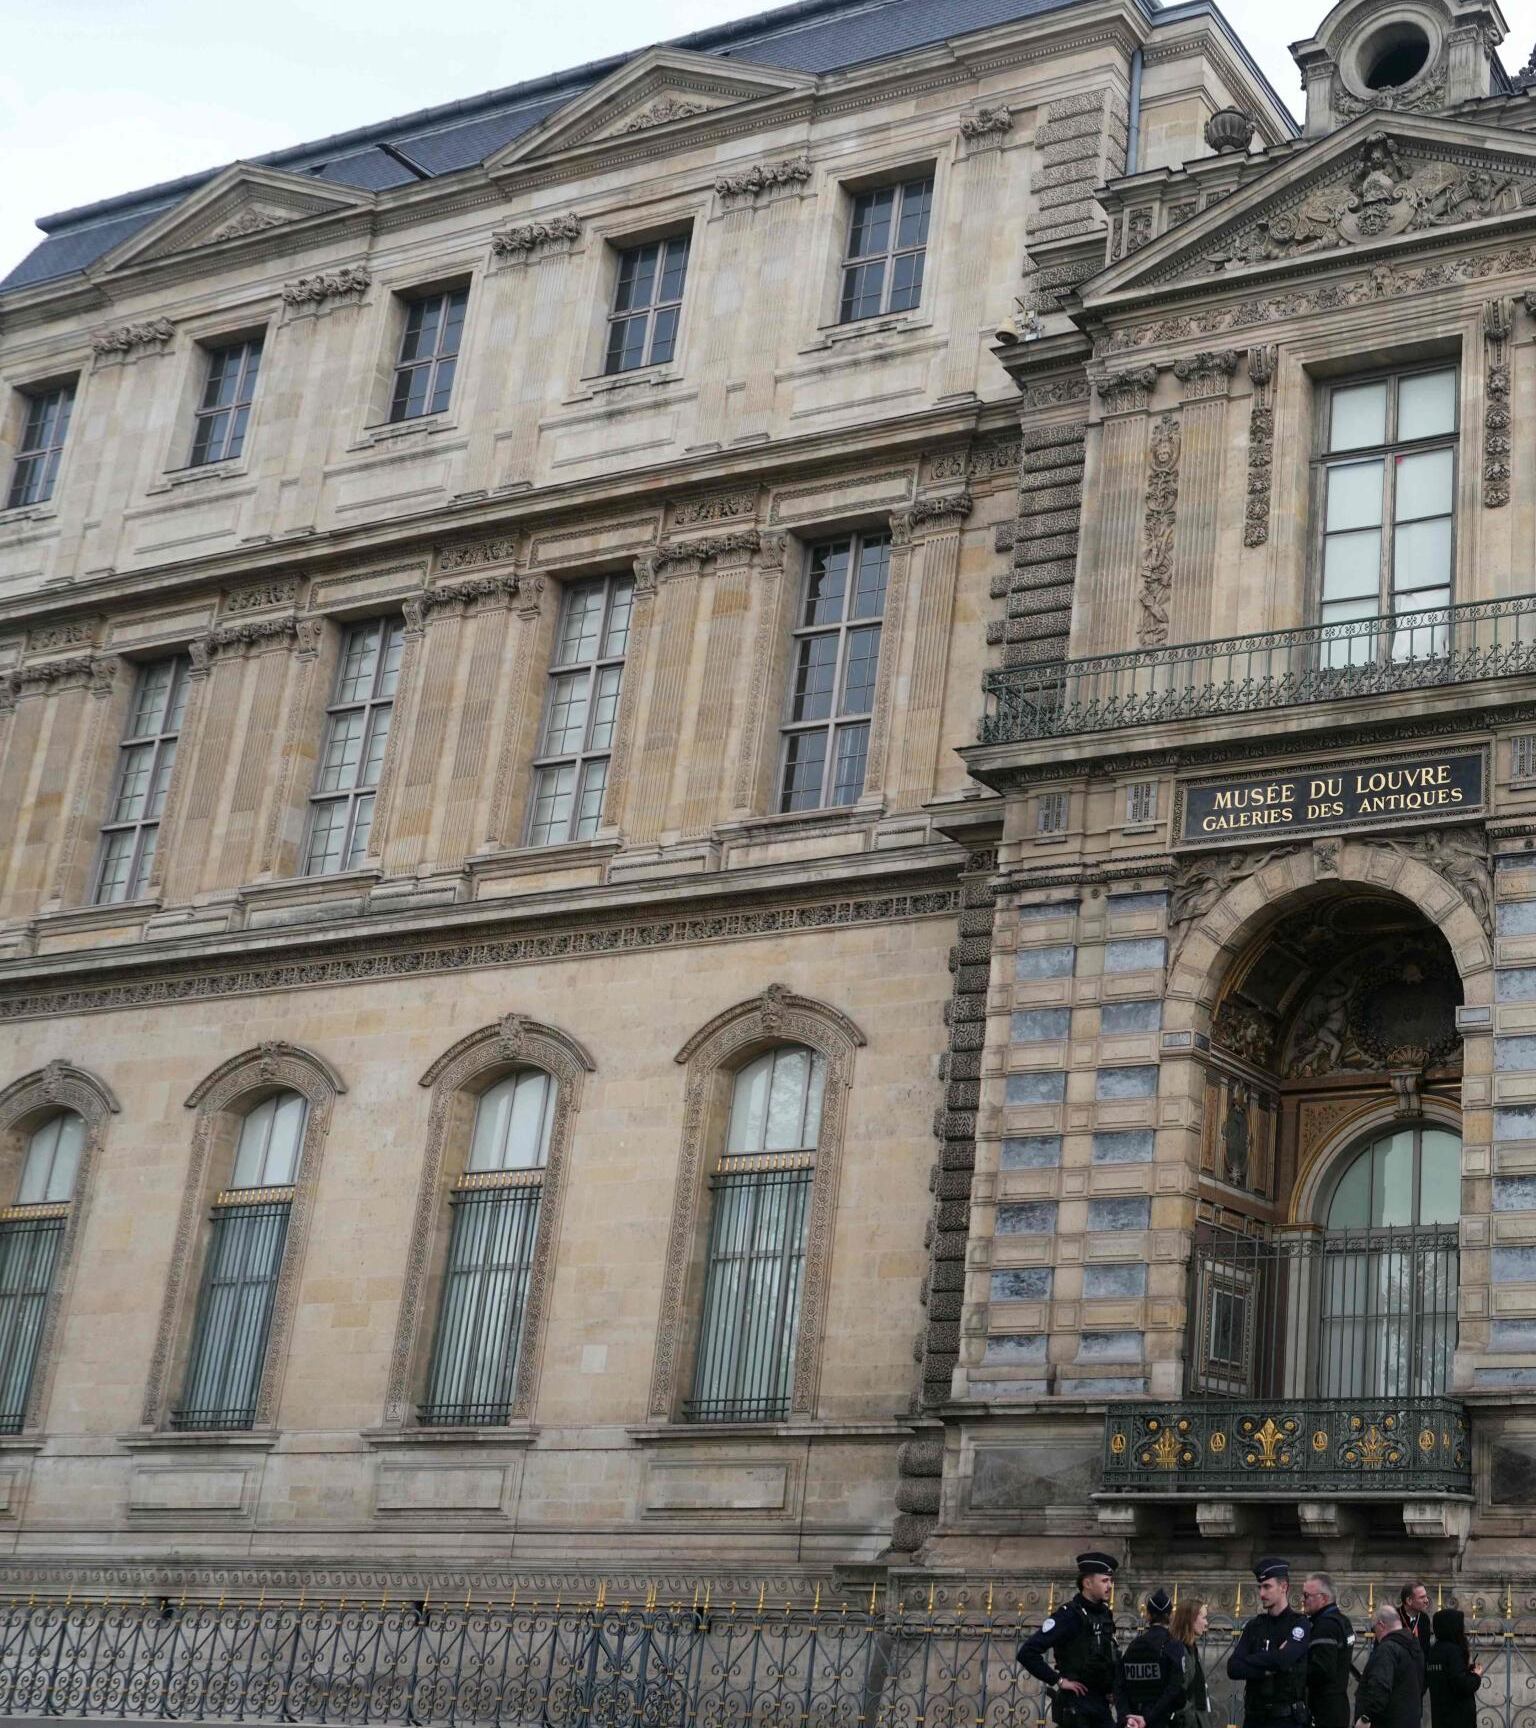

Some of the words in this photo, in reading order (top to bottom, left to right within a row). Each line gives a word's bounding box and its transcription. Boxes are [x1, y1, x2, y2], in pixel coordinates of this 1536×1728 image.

[1213, 782, 1295, 810] MUSÉE
[1310, 778, 1343, 799] DU
[1356, 765, 1451, 794] LOUVRE
[1202, 808, 1293, 832] GALERIES
[1307, 801, 1344, 819] DES
[1358, 788, 1463, 813] ANTIQUES
[1124, 1664, 1159, 1679] POLICE
